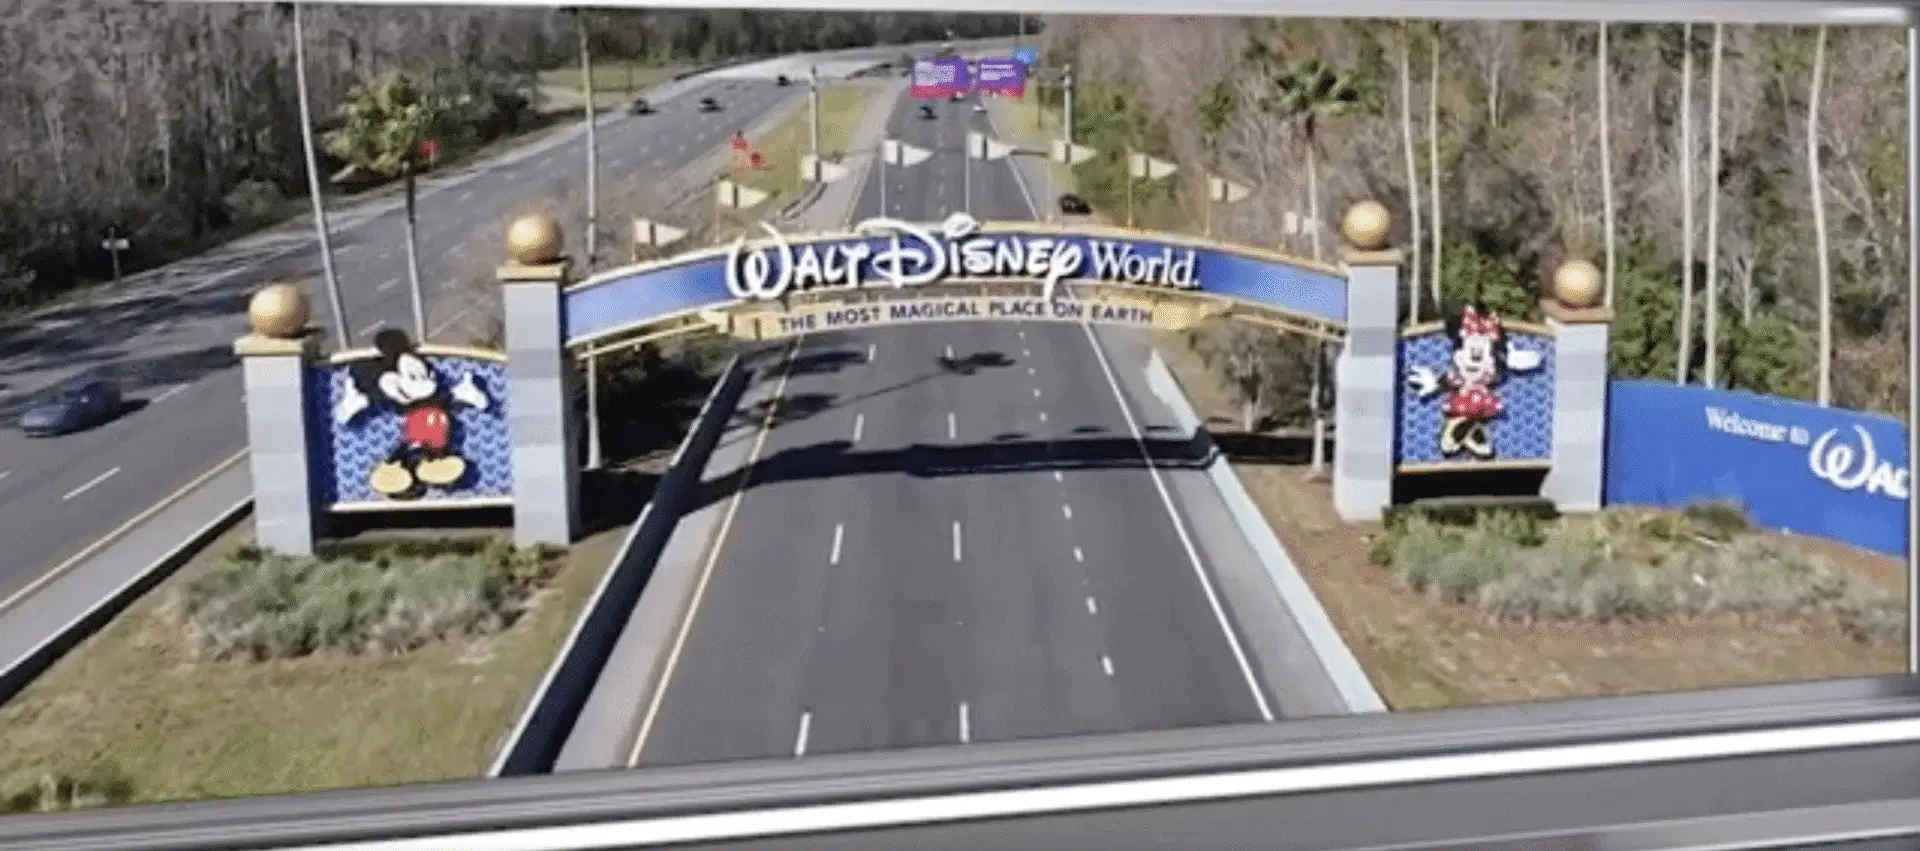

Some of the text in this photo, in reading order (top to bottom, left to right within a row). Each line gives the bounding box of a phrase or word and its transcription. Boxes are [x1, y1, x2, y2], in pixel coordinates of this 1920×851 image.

[727, 222, 869, 298] WALT
[779, 301, 1153, 333] THE MOST MAGICAL PLACE ON EARTH
[1705, 406, 1788, 442] Welcome
[1790, 426, 1809, 445] to
